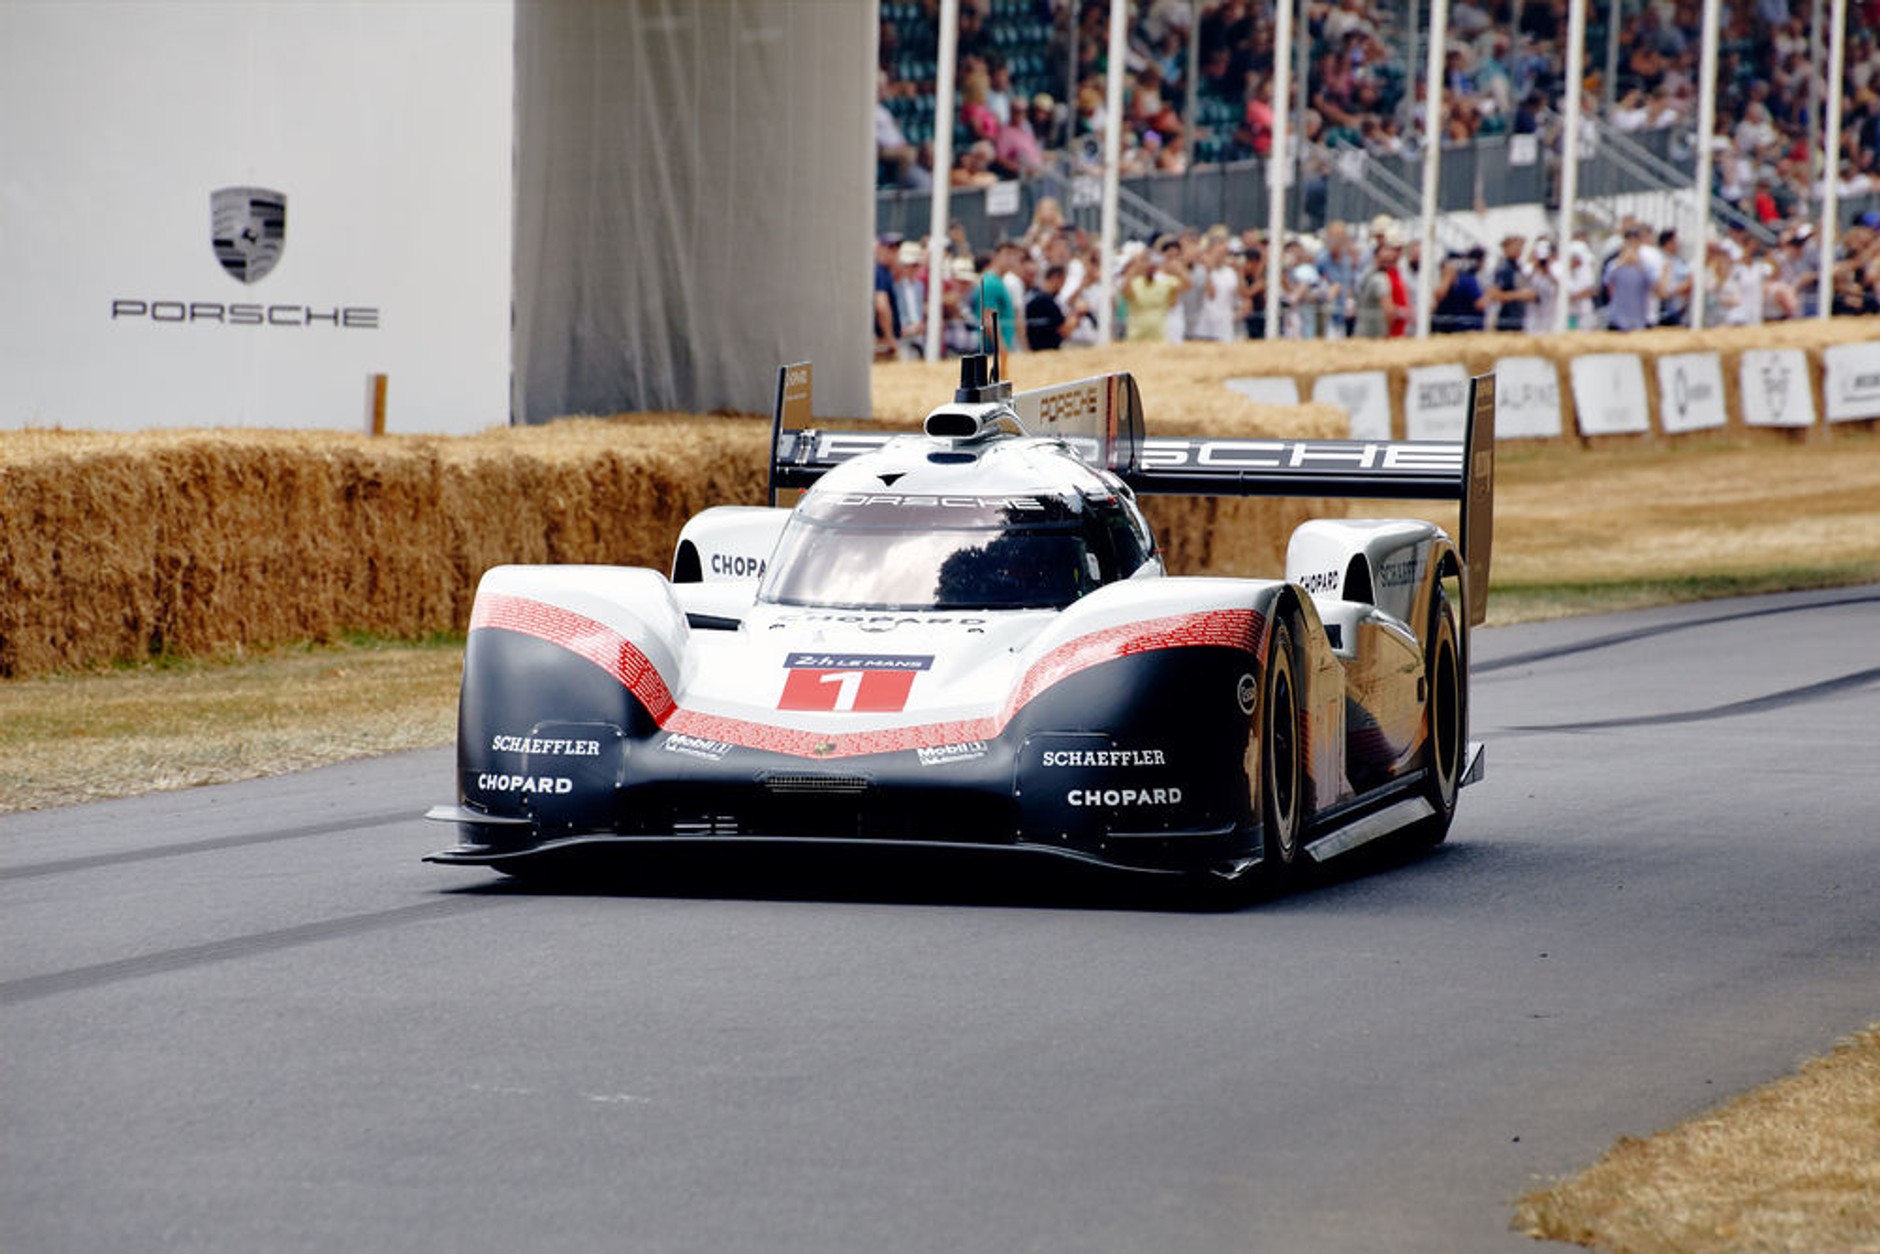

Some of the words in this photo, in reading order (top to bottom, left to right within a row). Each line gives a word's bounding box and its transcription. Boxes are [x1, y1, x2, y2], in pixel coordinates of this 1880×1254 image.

[111, 299, 380, 329] PORSCHE
[1299, 570, 1338, 594] CHOPARD
[865, 660, 922, 668] MANS
[819, 671, 864, 711] 1
[492, 735, 600, 755] SCHAEFFLER
[666, 733, 717, 751] Mobil
[917, 743, 968, 757] Mobil
[1042, 750, 1166, 768] SCHAEFFLER
[478, 774, 573, 794] CHOPARD
[1067, 787, 1183, 807] CHOPARD
